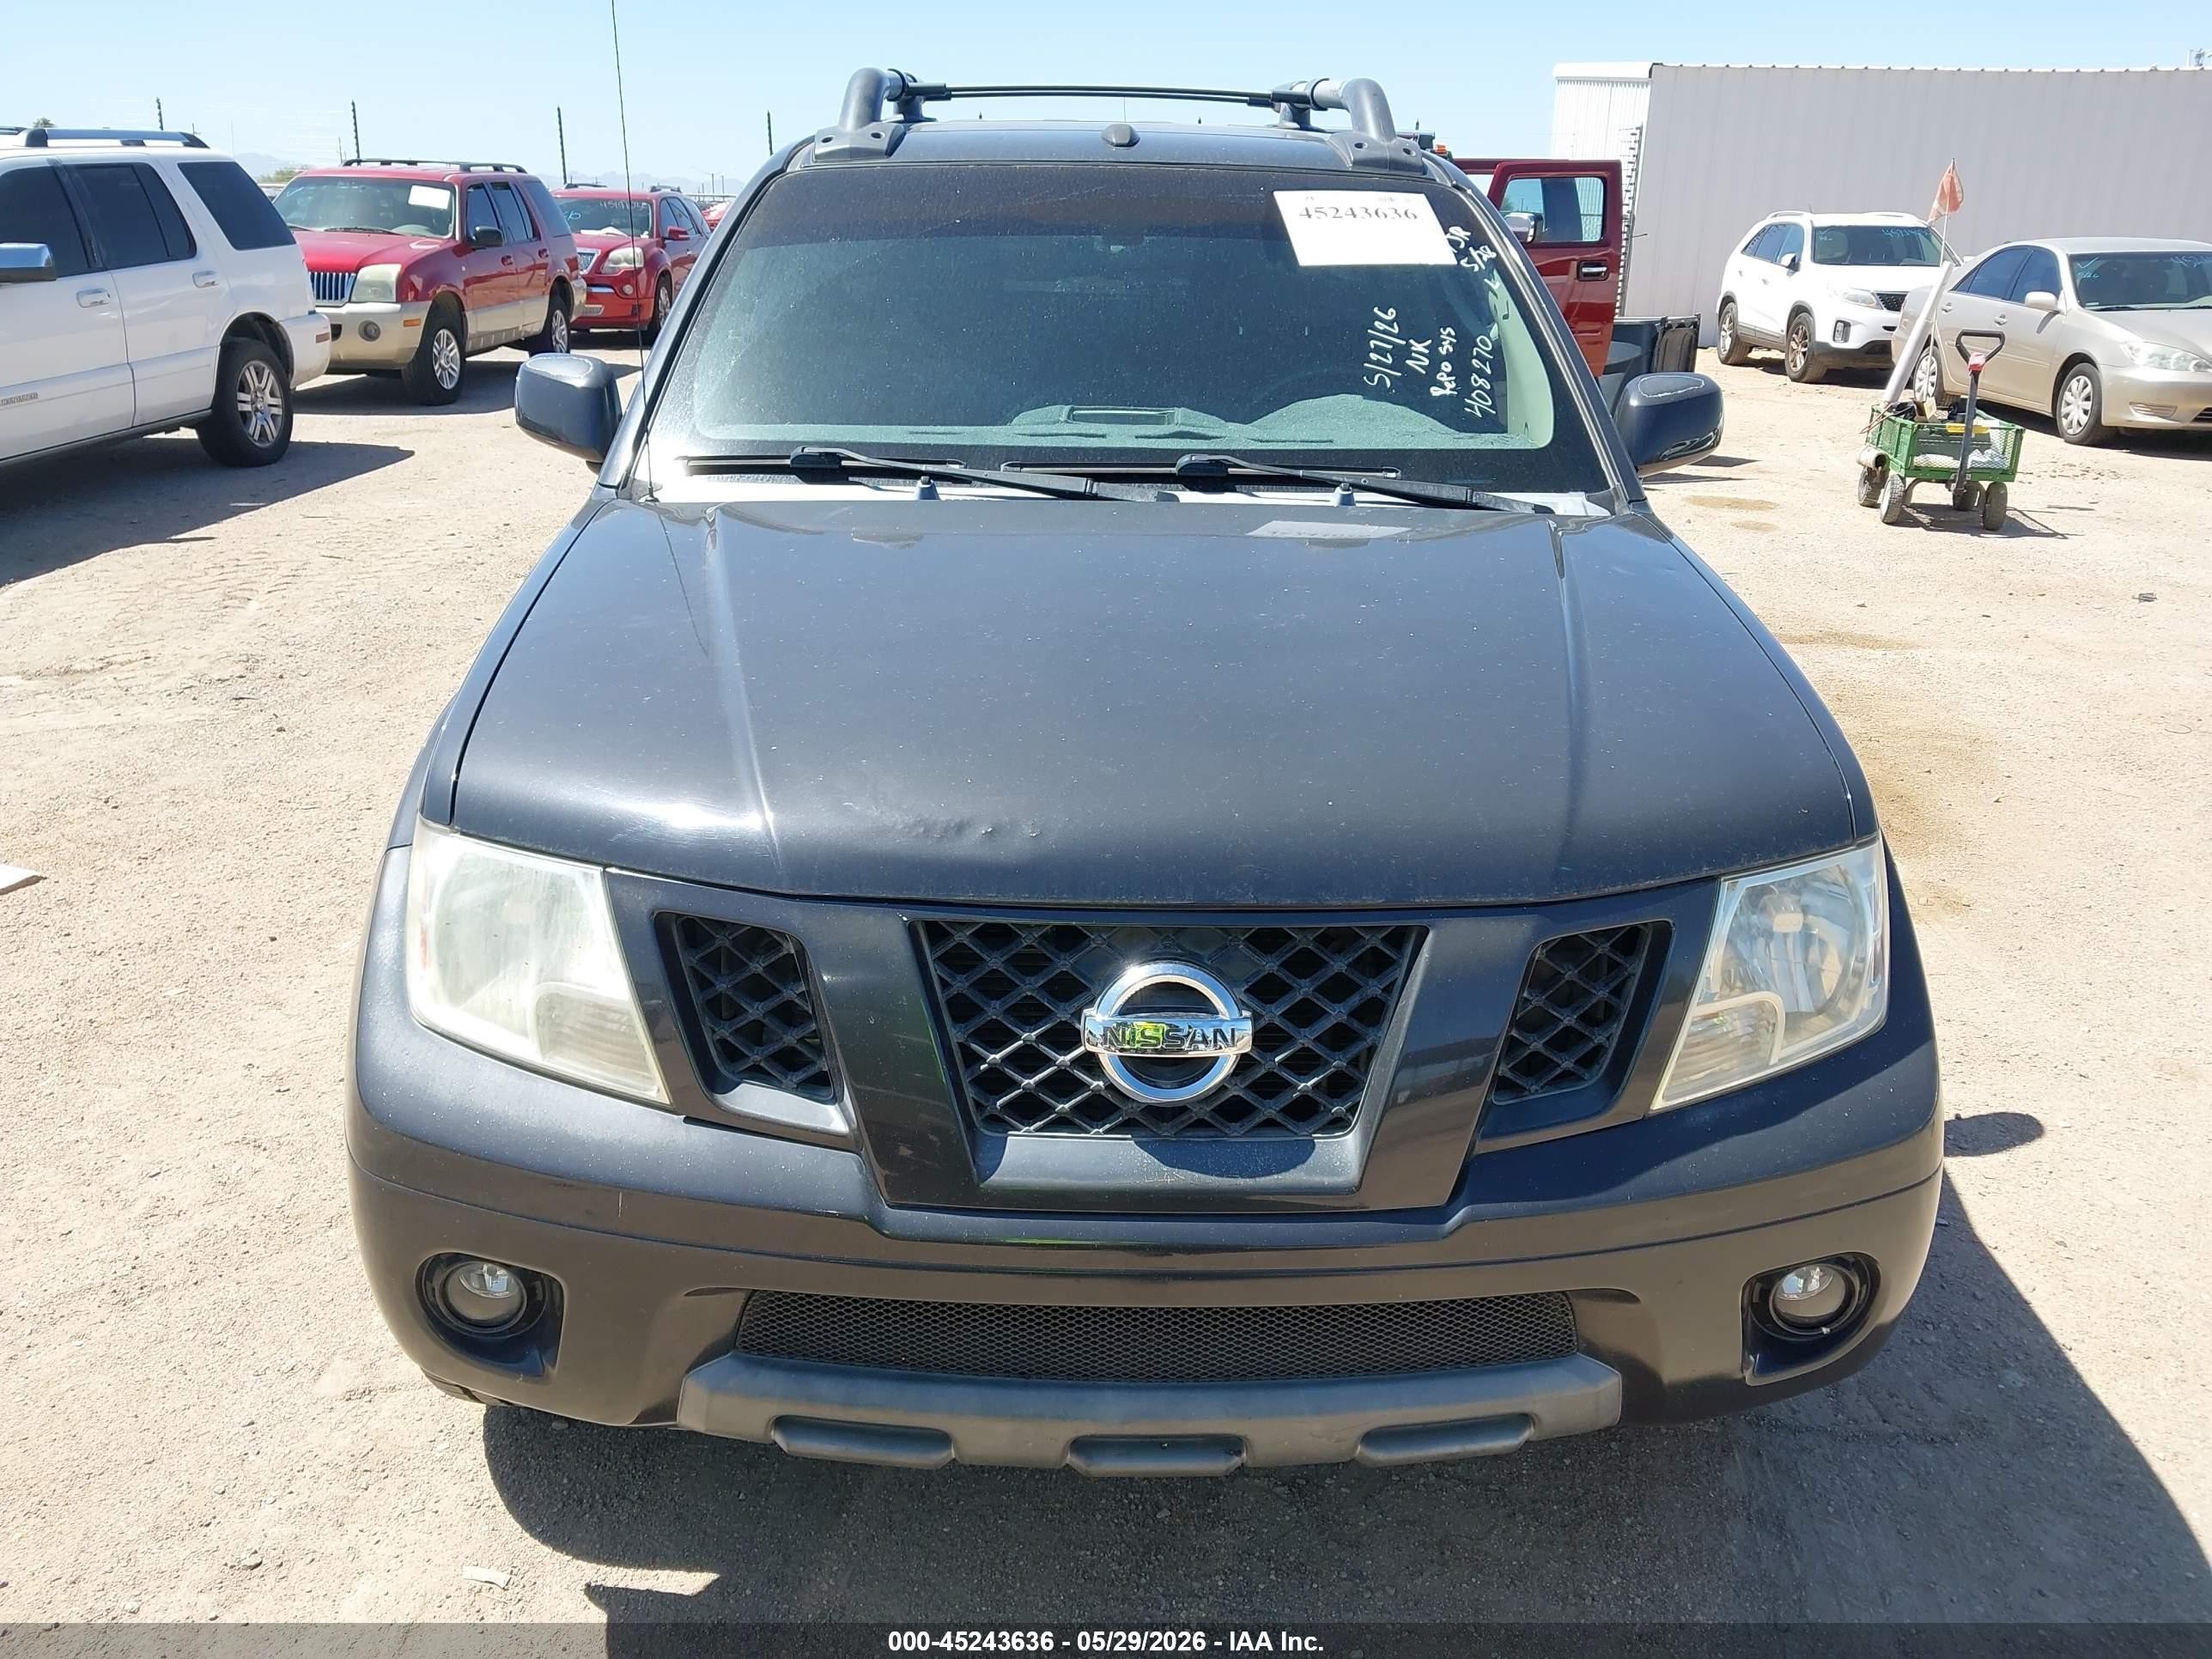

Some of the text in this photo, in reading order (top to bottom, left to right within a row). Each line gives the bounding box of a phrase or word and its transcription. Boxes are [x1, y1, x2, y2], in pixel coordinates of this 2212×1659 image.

[1299, 207, 1418, 220] 45243636
[1364, 307, 1407, 388] 5/27/26
[1405, 338, 1432, 374] NK
[1463, 335, 1496, 418] 408270
[1103, 1025, 1237, 1049] NISSAN
